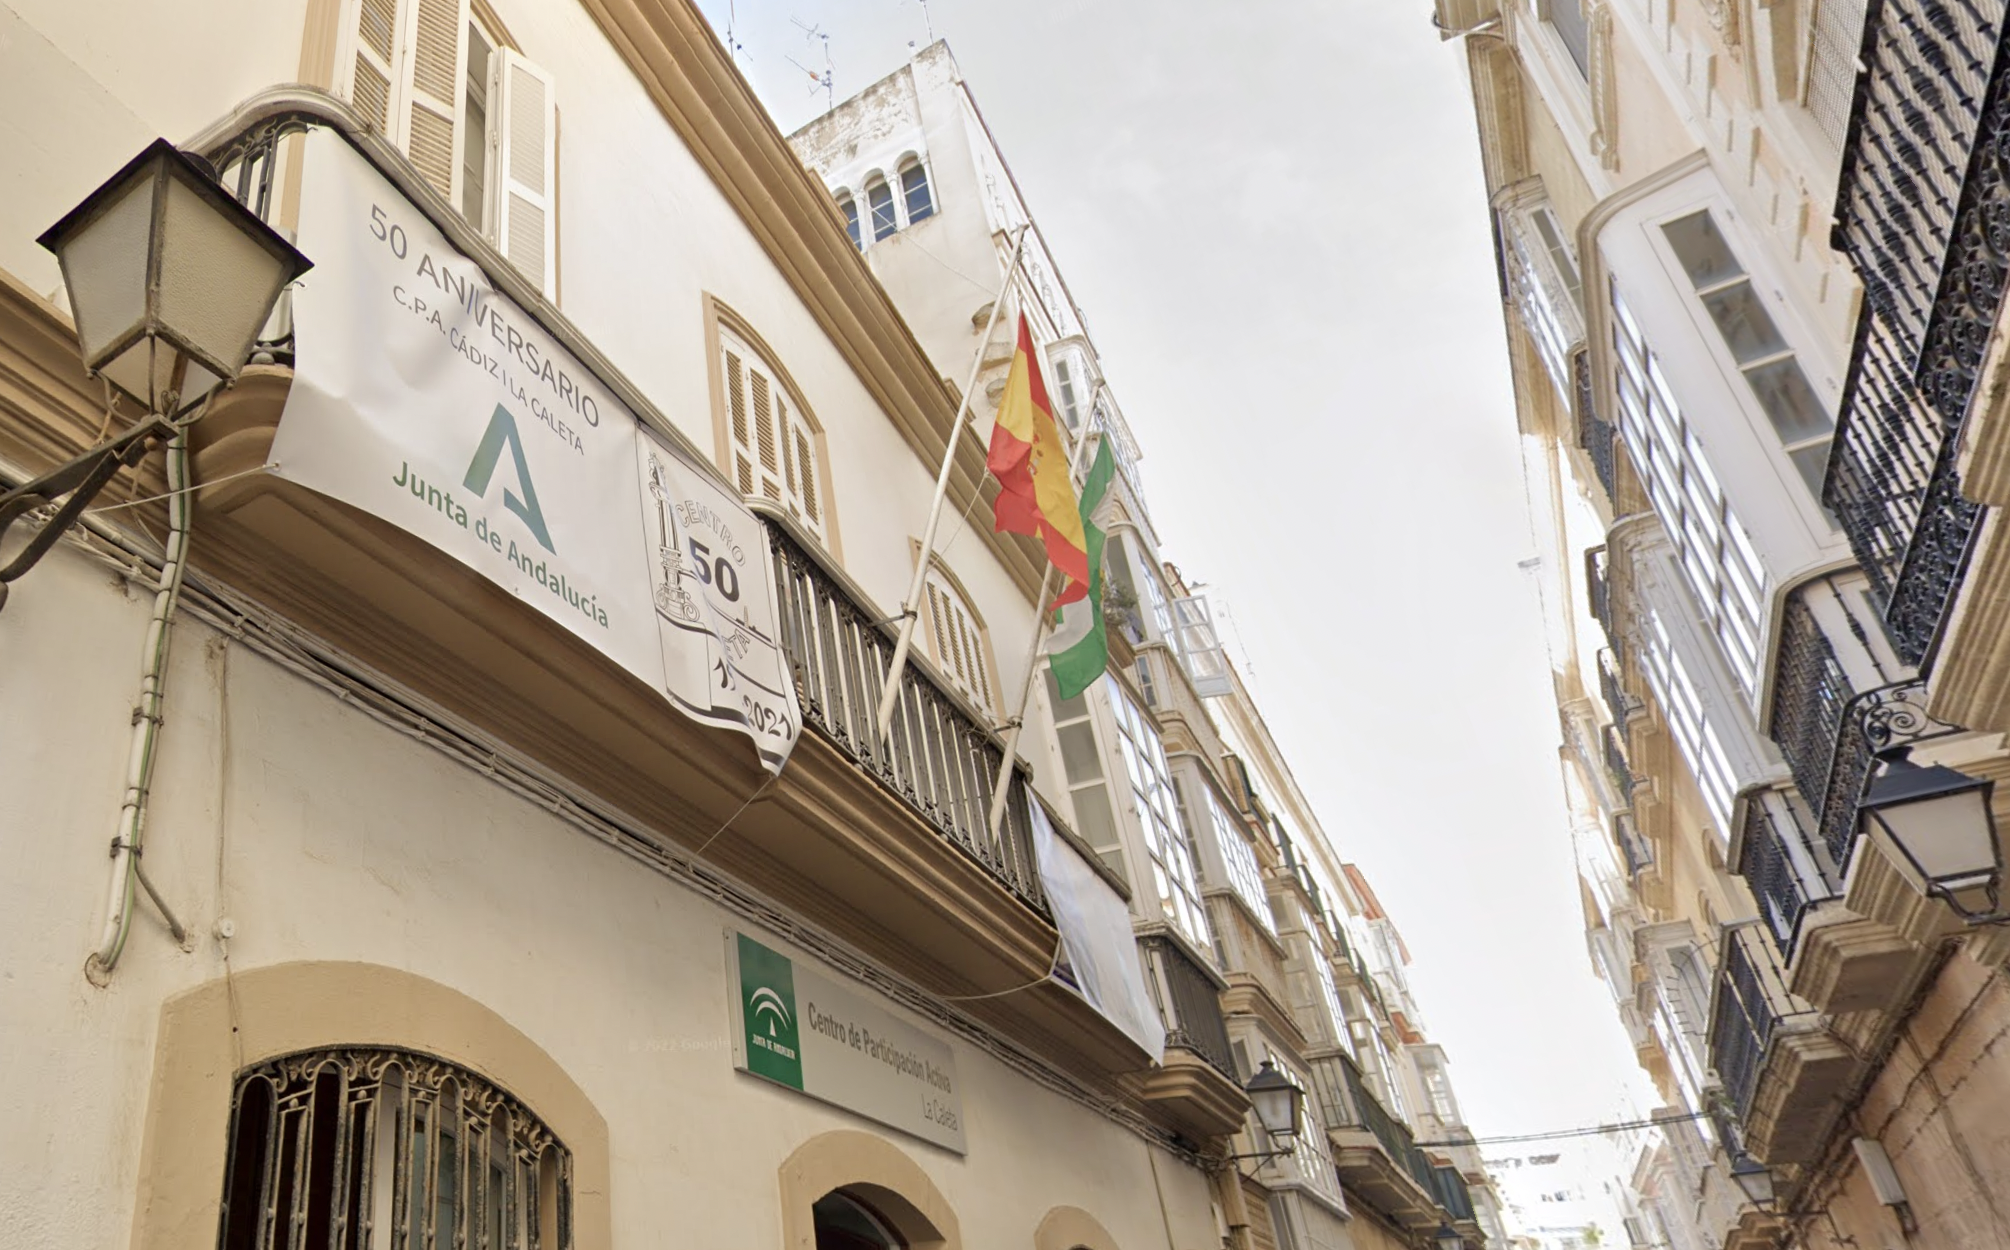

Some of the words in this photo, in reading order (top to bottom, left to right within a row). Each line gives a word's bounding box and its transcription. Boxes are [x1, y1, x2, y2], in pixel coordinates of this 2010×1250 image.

[370, 203, 407, 260] 50
[416, 253, 599, 428] ANIVERSARIO
[393, 285, 446, 336] C.P.A.
[450, 327, 499, 380] CÁDIZ
[510, 377, 528, 408] LA
[531, 397, 585, 456] CALETA
[392, 461, 469, 530] Junta
[475, 517, 502, 554] de
[507, 540, 609, 629] Andalucía
[675, 500, 746, 567] CENTRO
[688, 536, 740, 603] 50
[743, 694, 793, 741] 2021
[808, 1001, 846, 1044] Centro
[849, 1022, 862, 1051] de
[862, 1027, 925, 1083] Participación
[925, 1059, 952, 1094] Activa
[921, 1093, 934, 1121] La
[933, 1099, 958, 1131] Caleta
